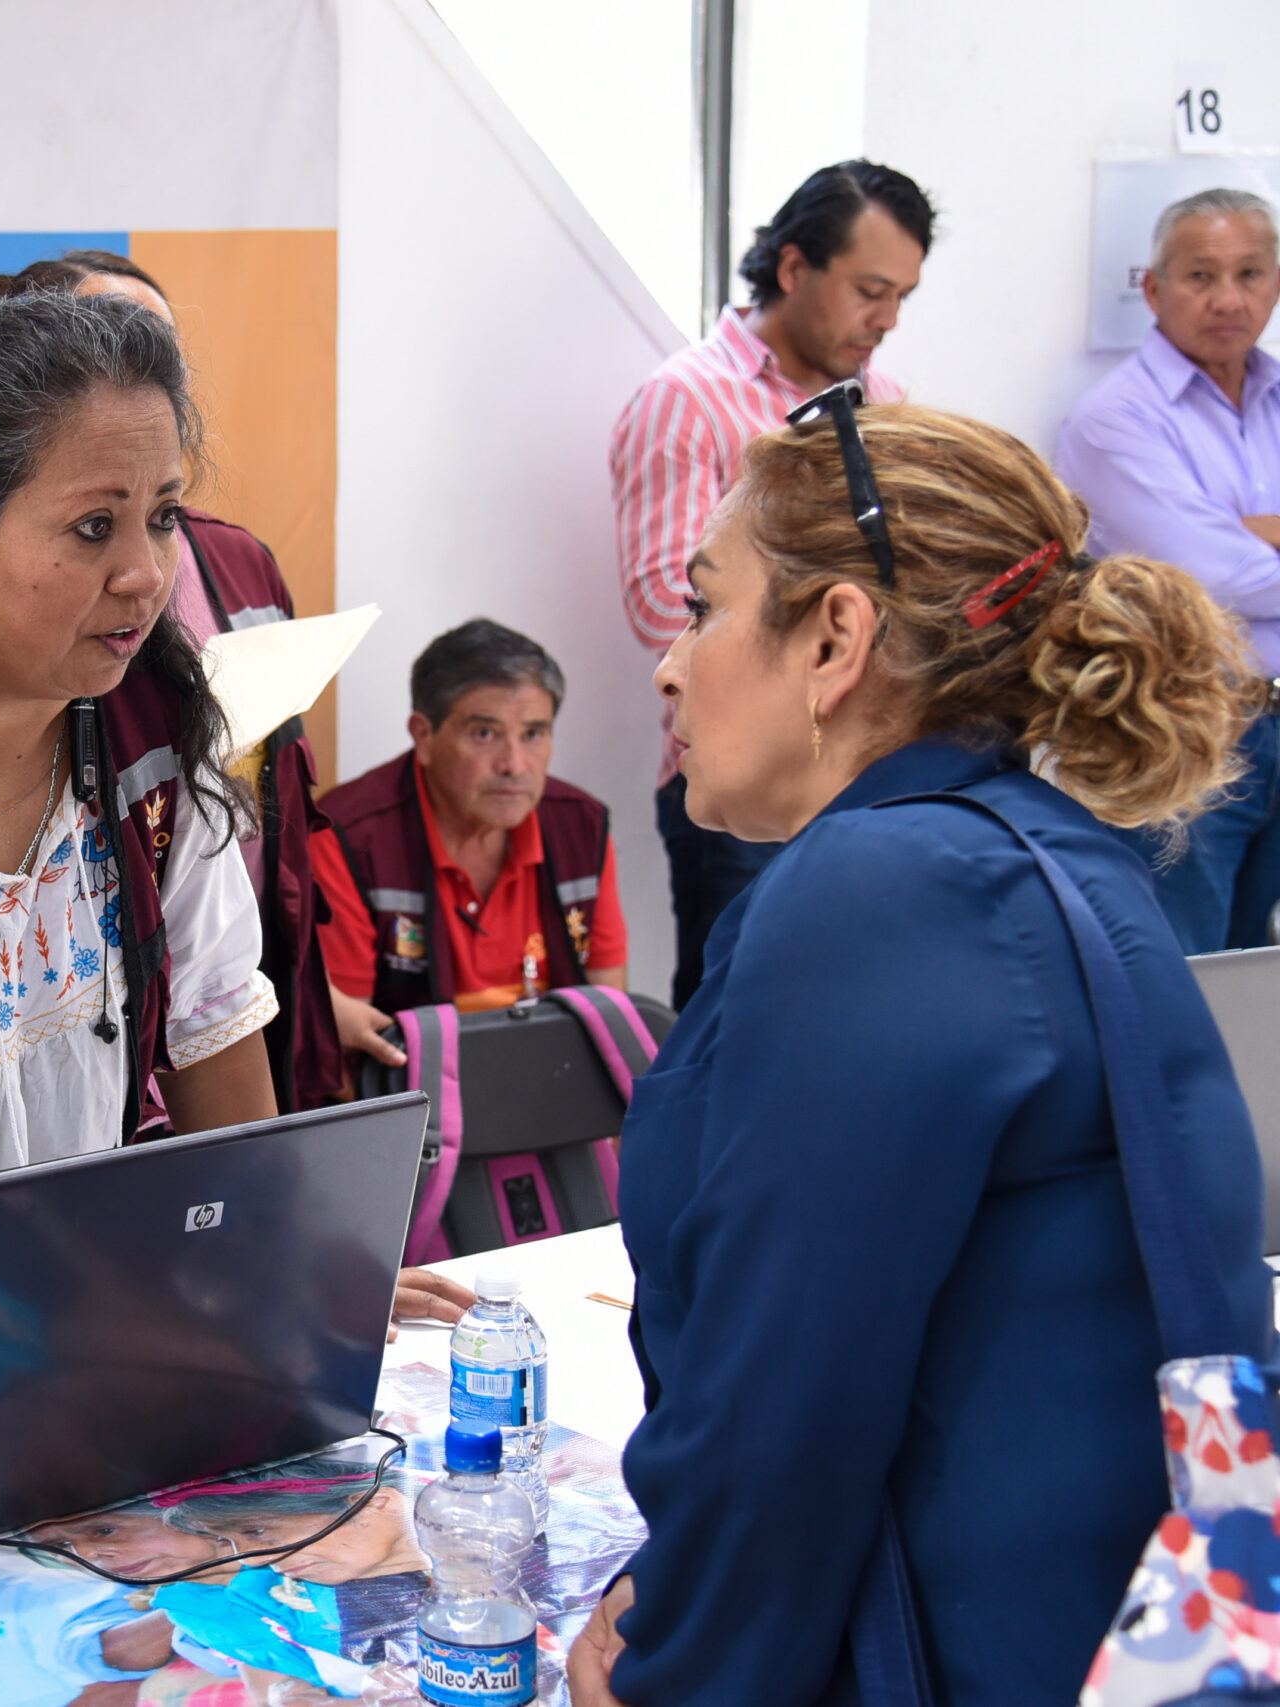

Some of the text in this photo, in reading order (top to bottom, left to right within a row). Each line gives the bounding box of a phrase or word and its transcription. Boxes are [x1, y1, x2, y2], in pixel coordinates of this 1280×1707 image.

[1176, 87, 1222, 134] 18
[195, 1204, 215, 1229] hp
[469, 1666, 518, 1690] Azul
